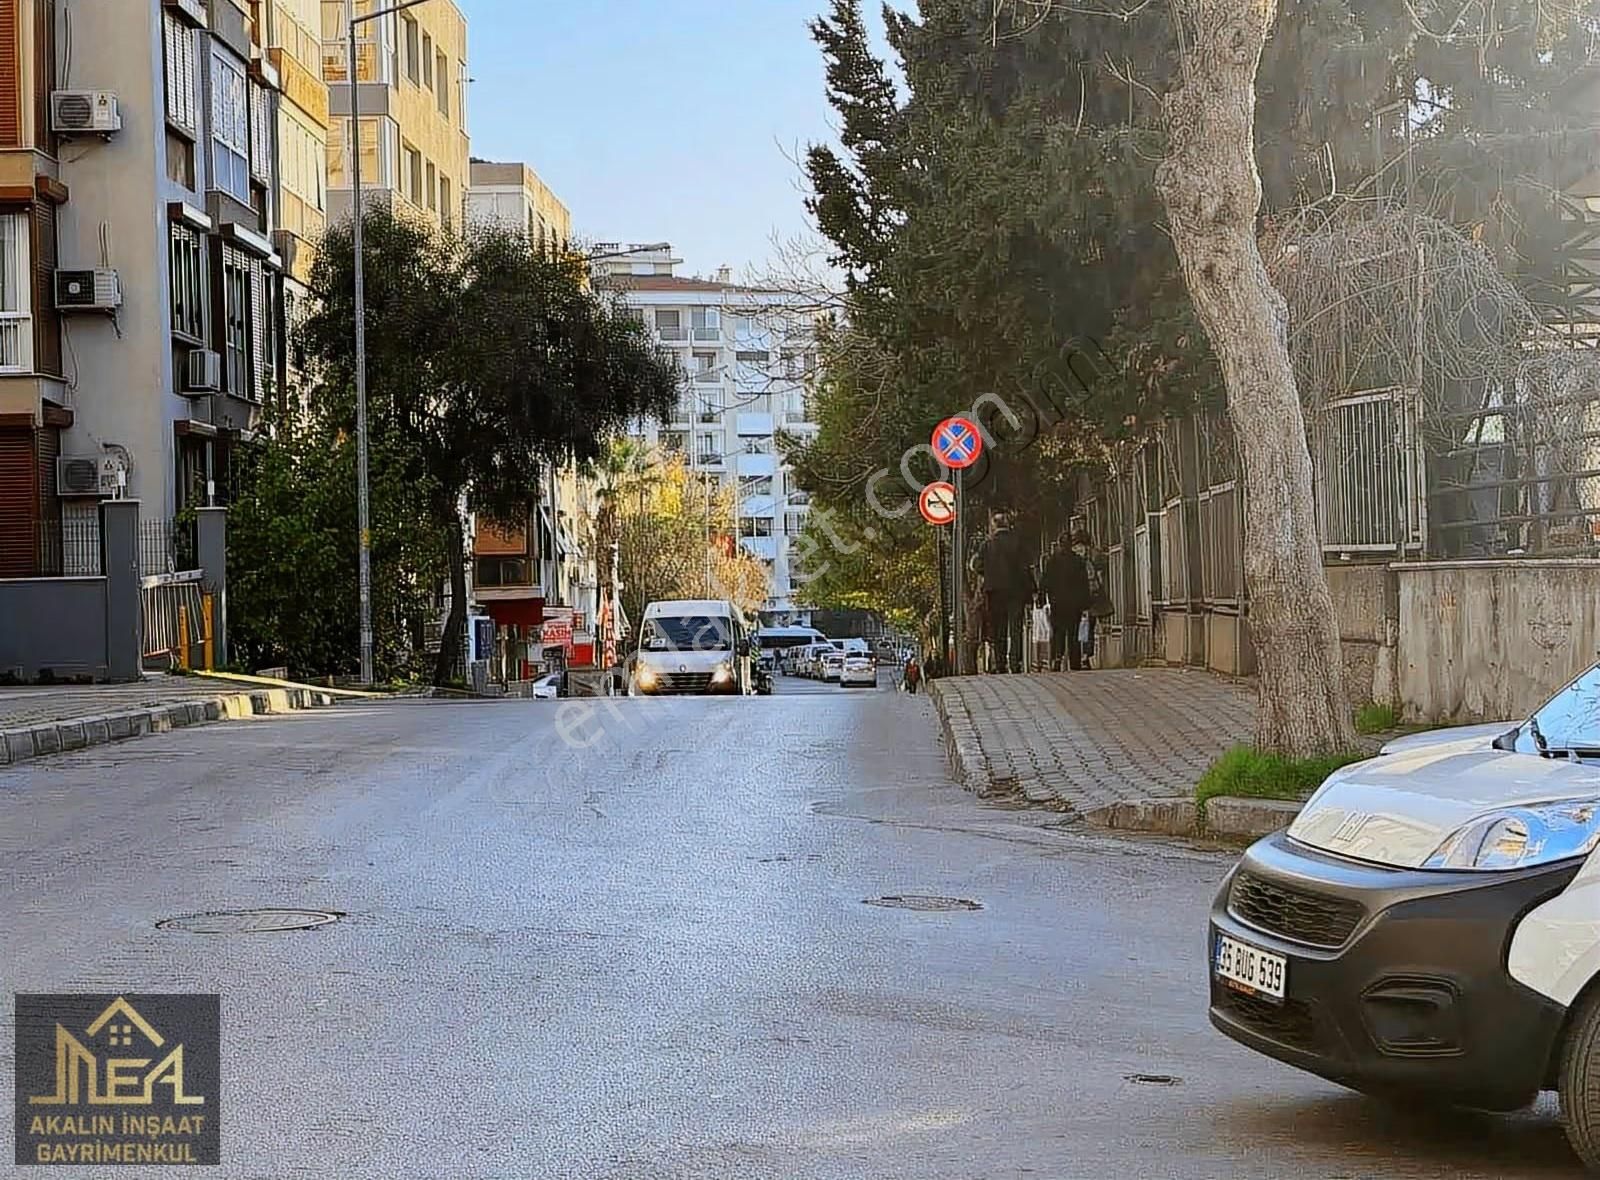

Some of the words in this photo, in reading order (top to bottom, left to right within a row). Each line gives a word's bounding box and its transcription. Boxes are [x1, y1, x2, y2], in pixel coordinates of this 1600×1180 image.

[1220, 941, 1232, 973] 35
[1235, 947, 1255, 981] BUG
[1259, 956, 1282, 991] 539
